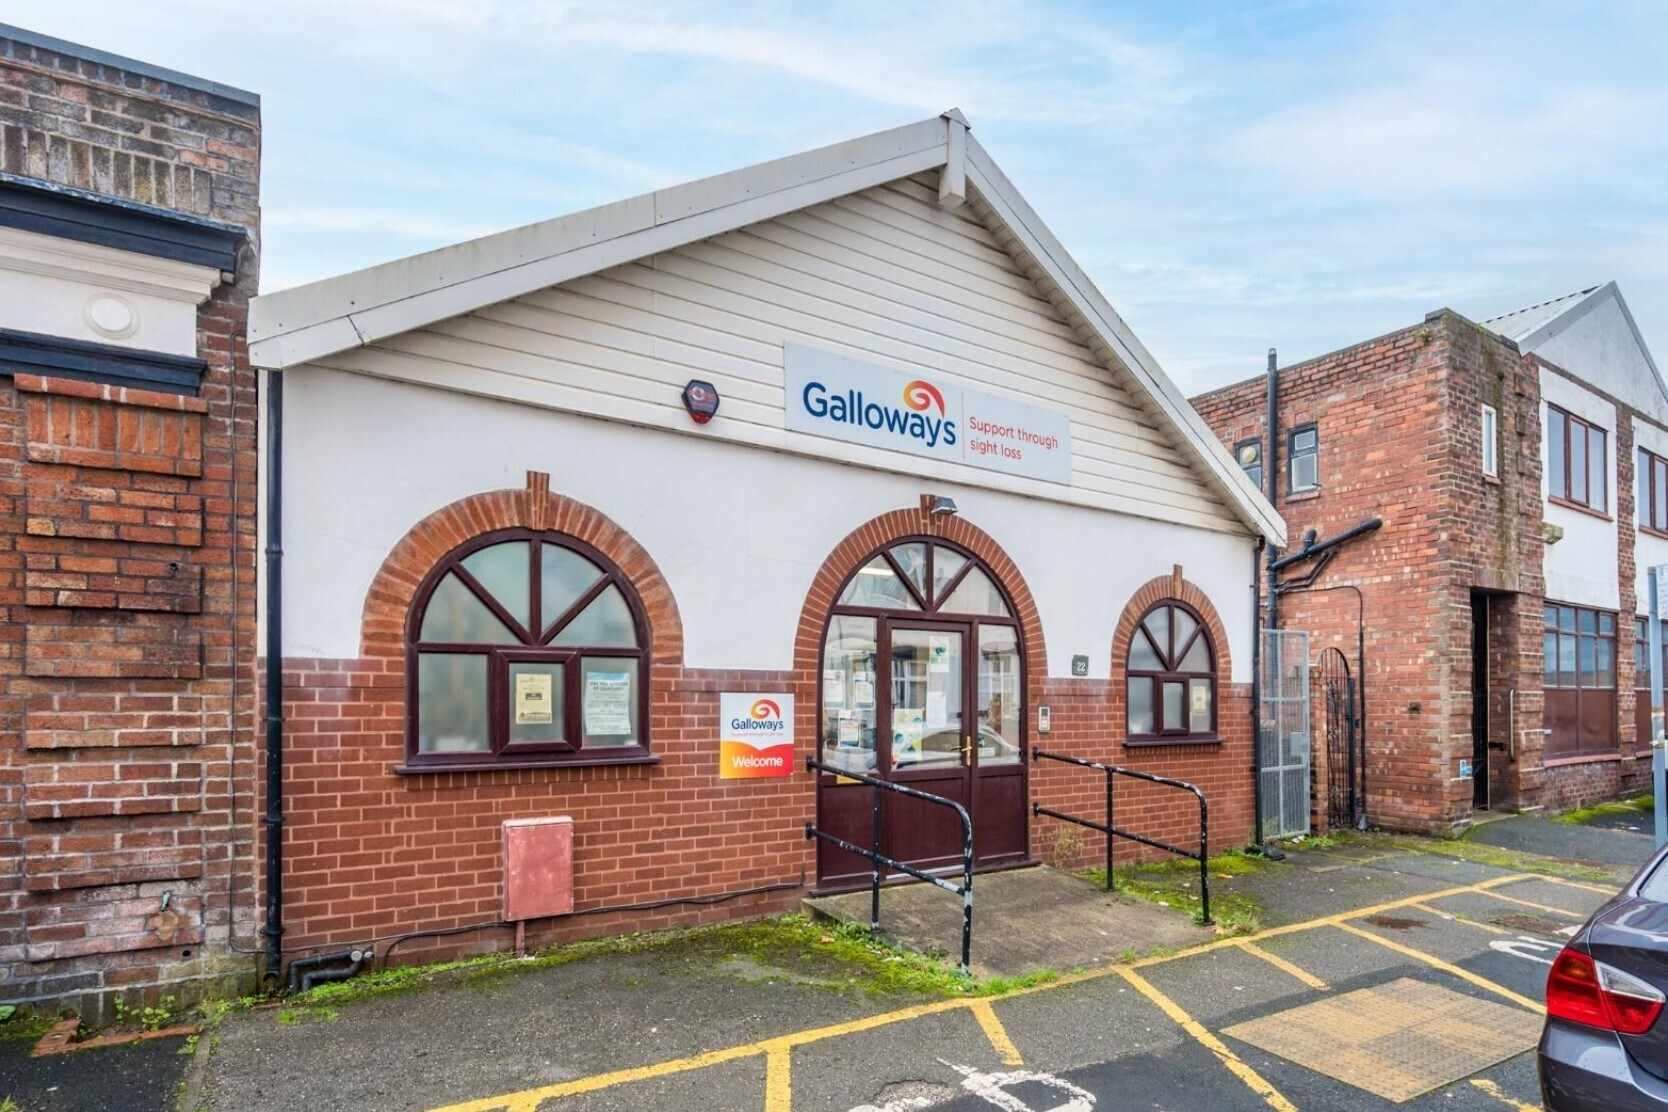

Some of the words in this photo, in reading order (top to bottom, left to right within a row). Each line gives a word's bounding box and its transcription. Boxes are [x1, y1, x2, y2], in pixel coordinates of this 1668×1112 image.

[803, 381, 956, 447] Galloways
[969, 416, 1014, 438] Support
[1018, 428, 1058, 449] through
[970, 438, 998, 455] sight
[1001, 444, 1022, 460] loss
[1076, 660, 1086, 672] 22
[731, 718, 784, 731] Galloways
[732, 755, 784, 768] Welcome
